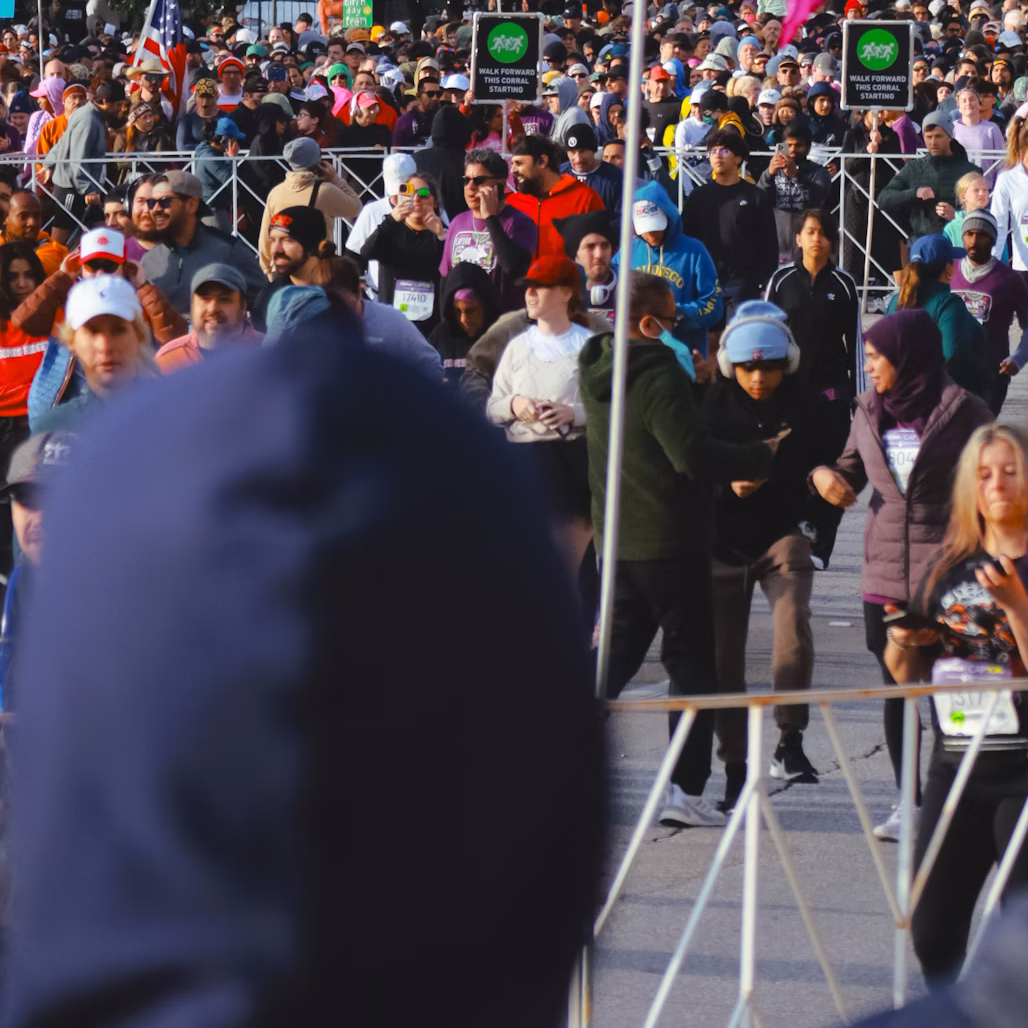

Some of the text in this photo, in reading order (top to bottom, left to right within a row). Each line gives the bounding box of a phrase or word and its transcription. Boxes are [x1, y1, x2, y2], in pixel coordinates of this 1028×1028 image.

[501, 68, 536, 76] FORWARD
[501, 77, 530, 85] CORRAL
[871, 75, 907, 83] FORWARD
[489, 85, 524, 94] STARTING
[855, 83, 900, 92] THIS CORRAL
